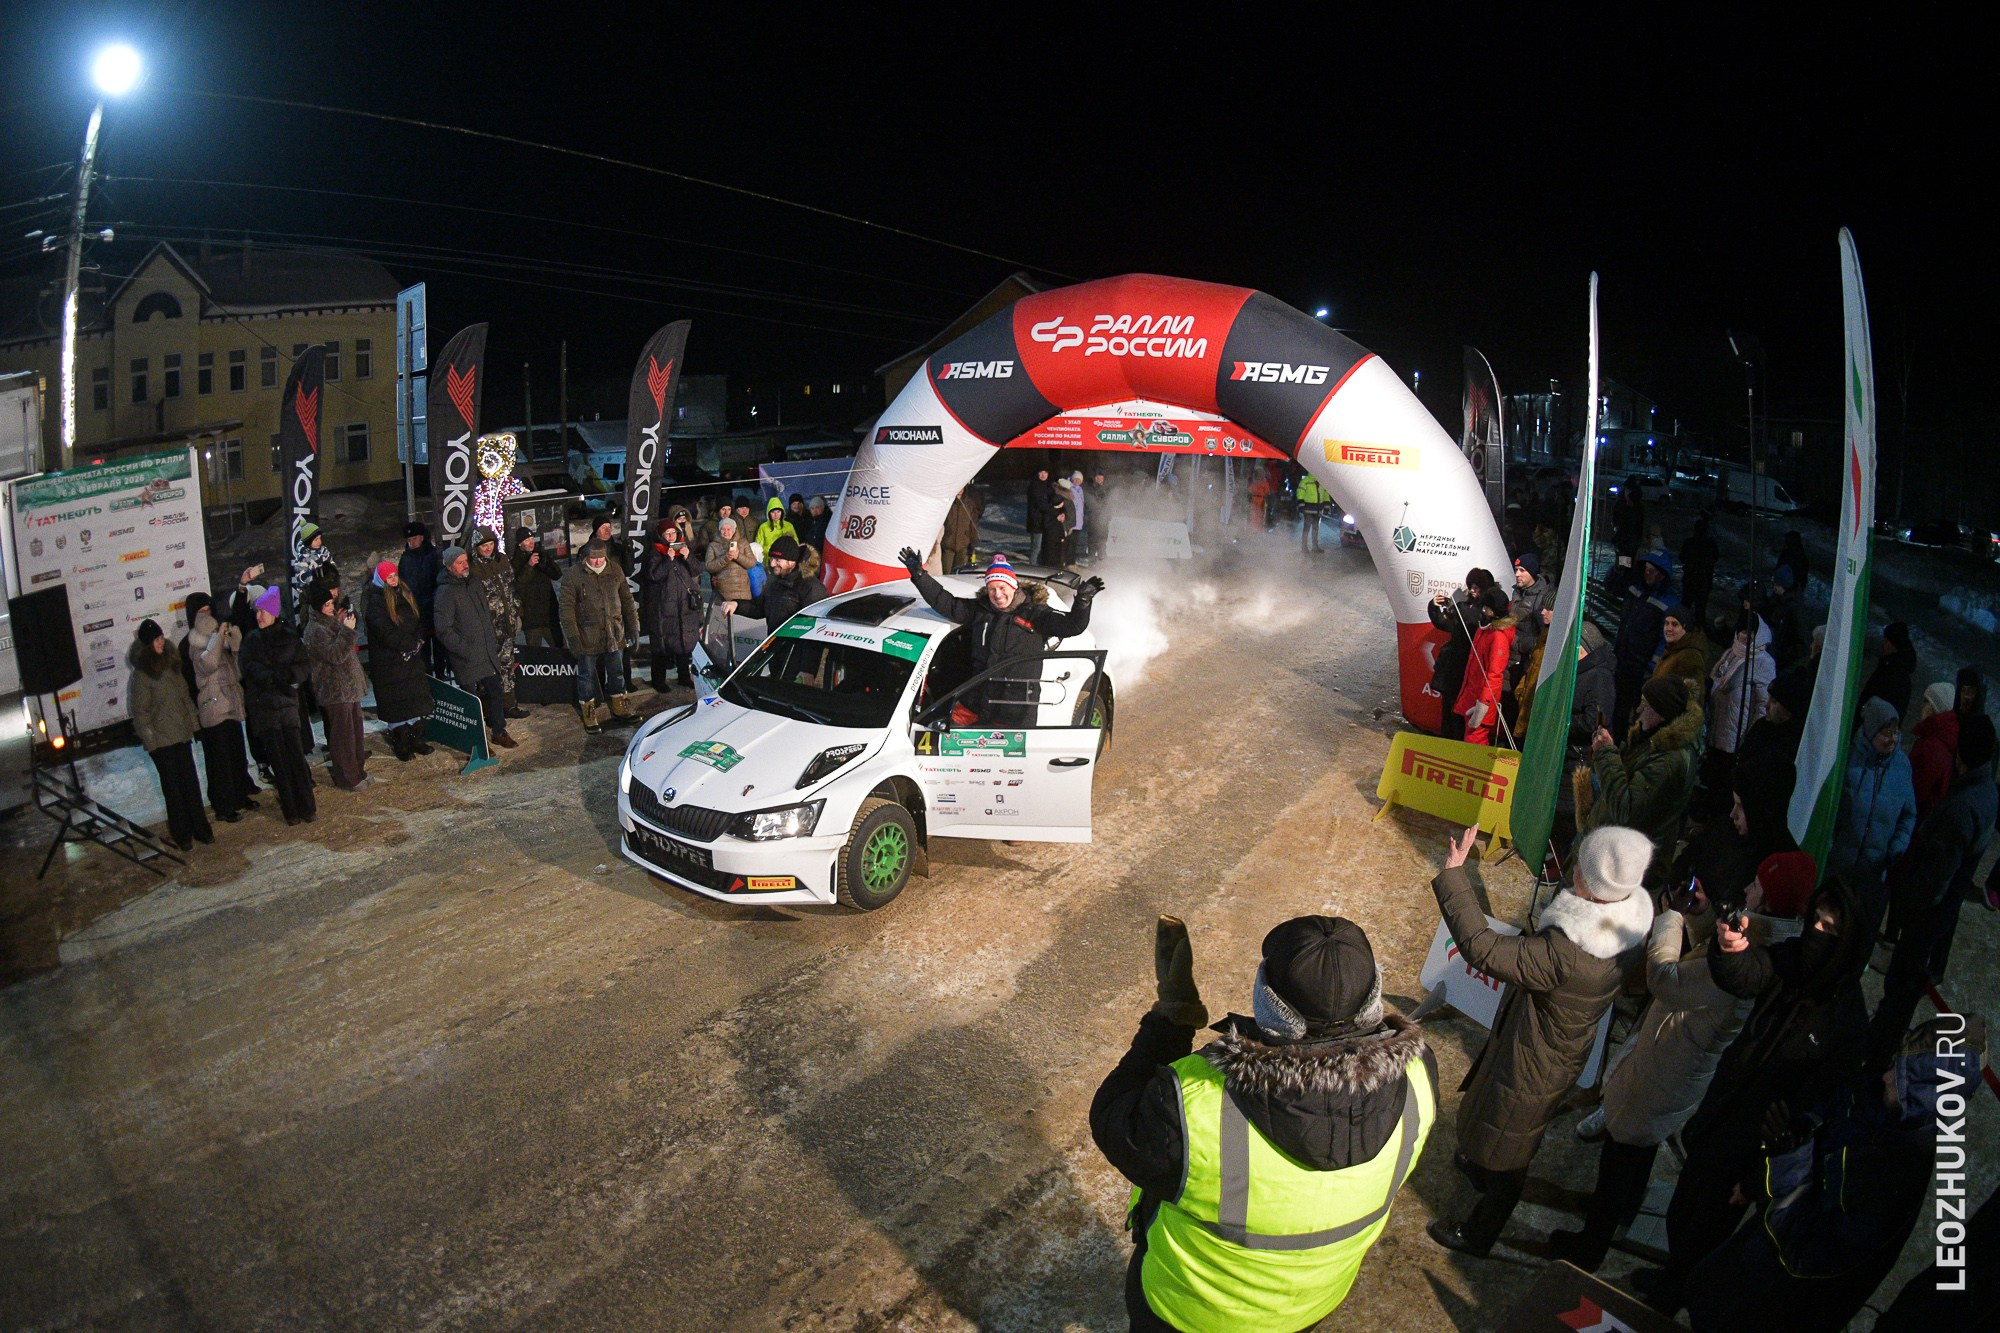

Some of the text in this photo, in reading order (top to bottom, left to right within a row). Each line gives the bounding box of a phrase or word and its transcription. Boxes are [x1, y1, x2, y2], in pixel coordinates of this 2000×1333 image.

[1090, 314, 1195, 334] РАЛЛИ
[1085, 336, 1208, 359] РОССИИ
[946, 360, 1014, 380] ASMG
[1243, 361, 1331, 386] ASMG
[889, 430, 939, 440] YOKOHAMA
[1152, 435, 1189, 444] СУВОРОВ
[1341, 445, 1400, 465] PIRELLI
[103, 464, 139, 476] РОССИИ
[140, 460, 153, 468] ПО
[155, 454, 185, 466] РАЛЛИ
[78, 479, 122, 494] ФЕВРАЛЯ
[124, 474, 145, 485] 2026
[846, 485, 890, 499] SPACE
[36, 505, 102, 528] ТАТНЕФТЬ
[626, 421, 661, 594] YOKOHAM
[844, 515, 877, 540] R8
[1417, 541, 1471, 552] СТРОИТЕЛЬНЫЕ
[1419, 534, 1456, 543] НЕРУДНЫЕ
[1416, 548, 1458, 557] МАТЕРИАЛЫ
[1427, 587, 1449, 597] РУСЬ
[823, 630, 876, 645] ТАТНЕФТЬ
[519, 664, 579, 676] YOKOHAM
[911, 647, 935, 693] prospeedrally
[436, 700, 465, 714] НЕРУДНЫЕ
[436, 707, 478, 726] СТРОИТЕЛЬНЫЕ
[435, 714, 468, 730] МАТЕРИАЛЫ
[826, 743, 864, 758] PROSPEED
[918, 732, 932, 754] 4
[1401, 748, 1508, 803] PIRELLI
[751, 879, 791, 887] PIRELLI
